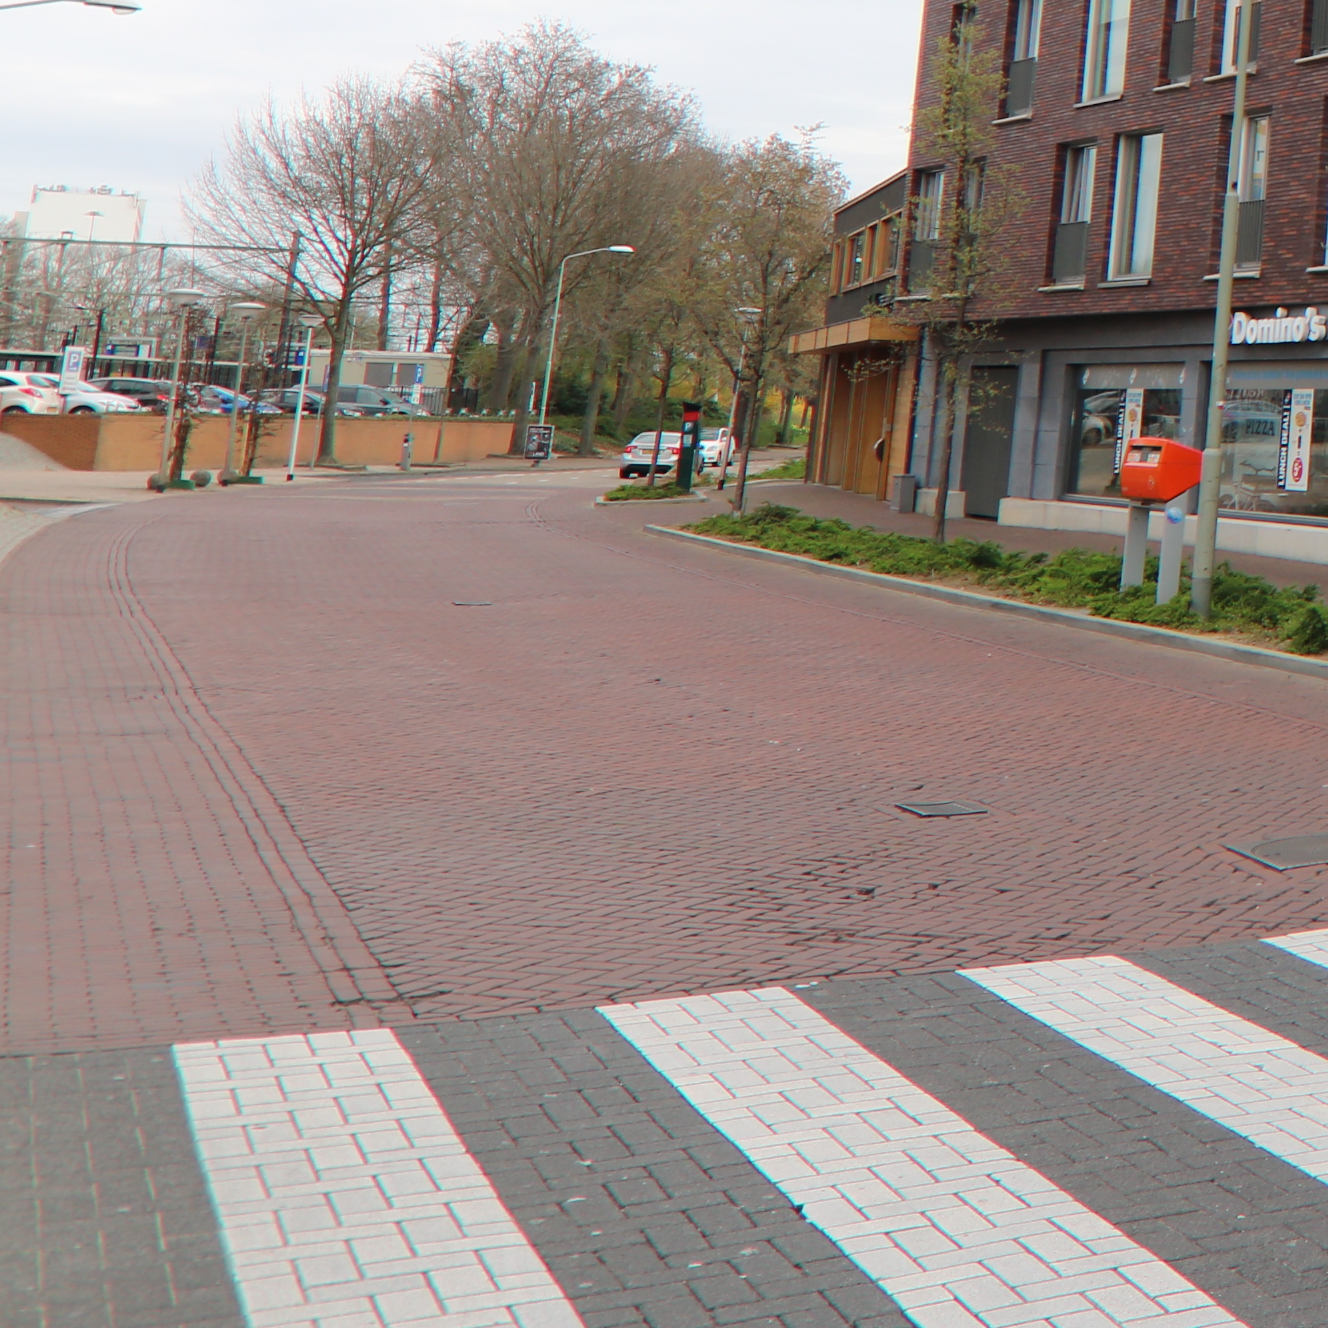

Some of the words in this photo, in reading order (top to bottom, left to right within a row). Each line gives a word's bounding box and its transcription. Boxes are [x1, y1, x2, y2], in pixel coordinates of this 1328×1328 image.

[1231, 306, 1327, 344] Domino's
[1245, 419, 1275, 436] PIZZA
[1113, 439, 1123, 474] LUNCH
[1277, 445, 1288, 487] LUNCH
